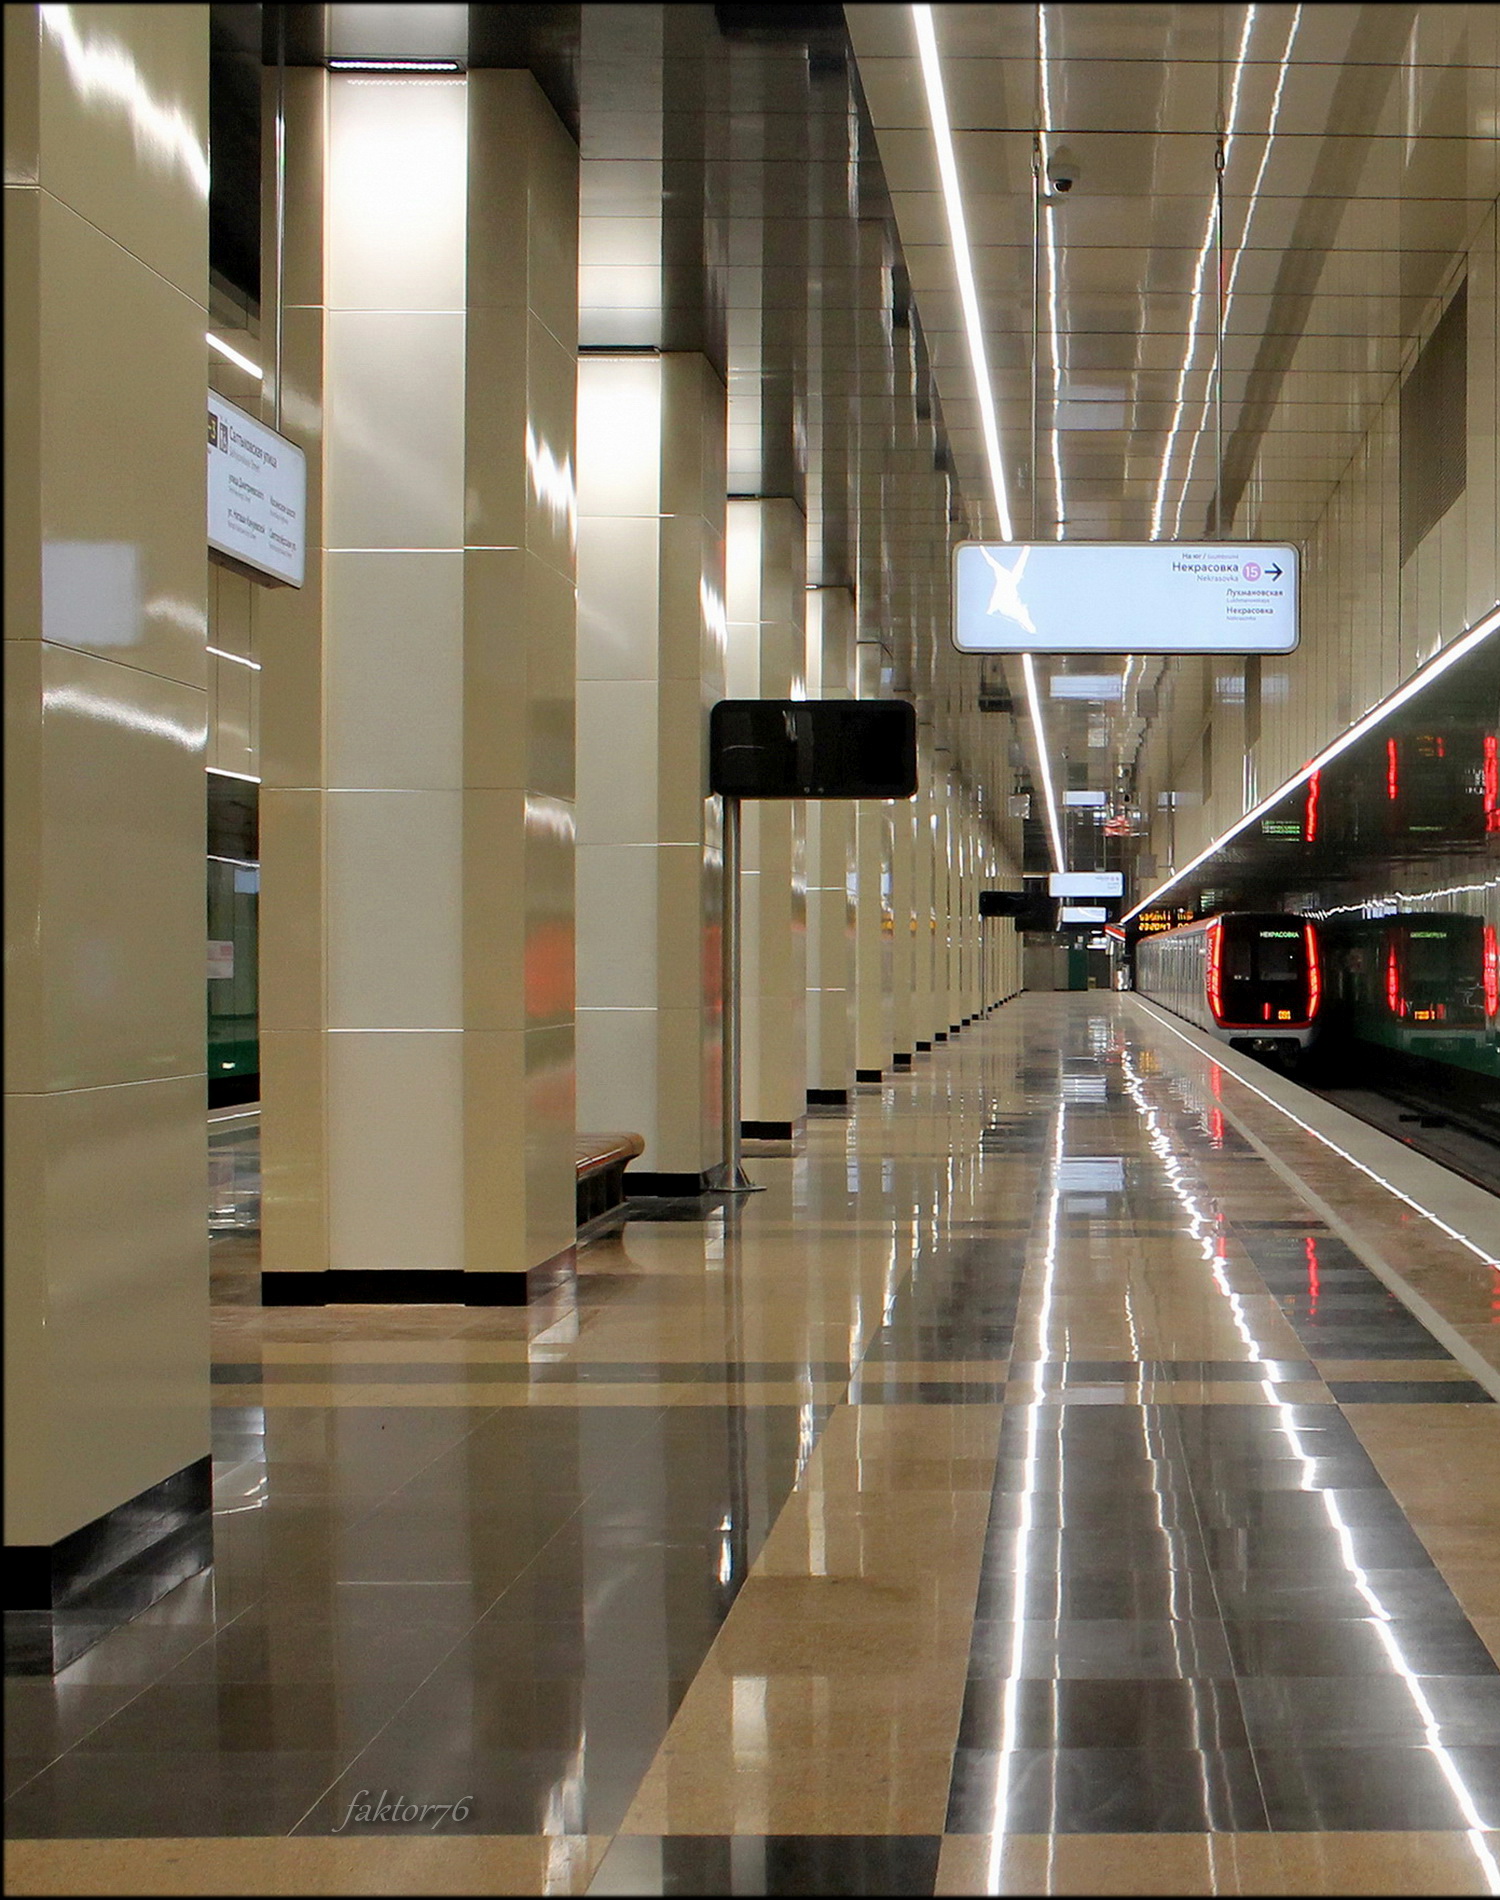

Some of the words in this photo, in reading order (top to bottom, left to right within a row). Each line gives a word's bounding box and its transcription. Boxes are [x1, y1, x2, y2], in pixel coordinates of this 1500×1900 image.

[1172, 562, 1239, 573] Некрасовка
[1245, 566, 1258, 577] 15
[1226, 588, 1283, 598] Лухмановская
[1226, 606, 1274, 615] Некрасовка
